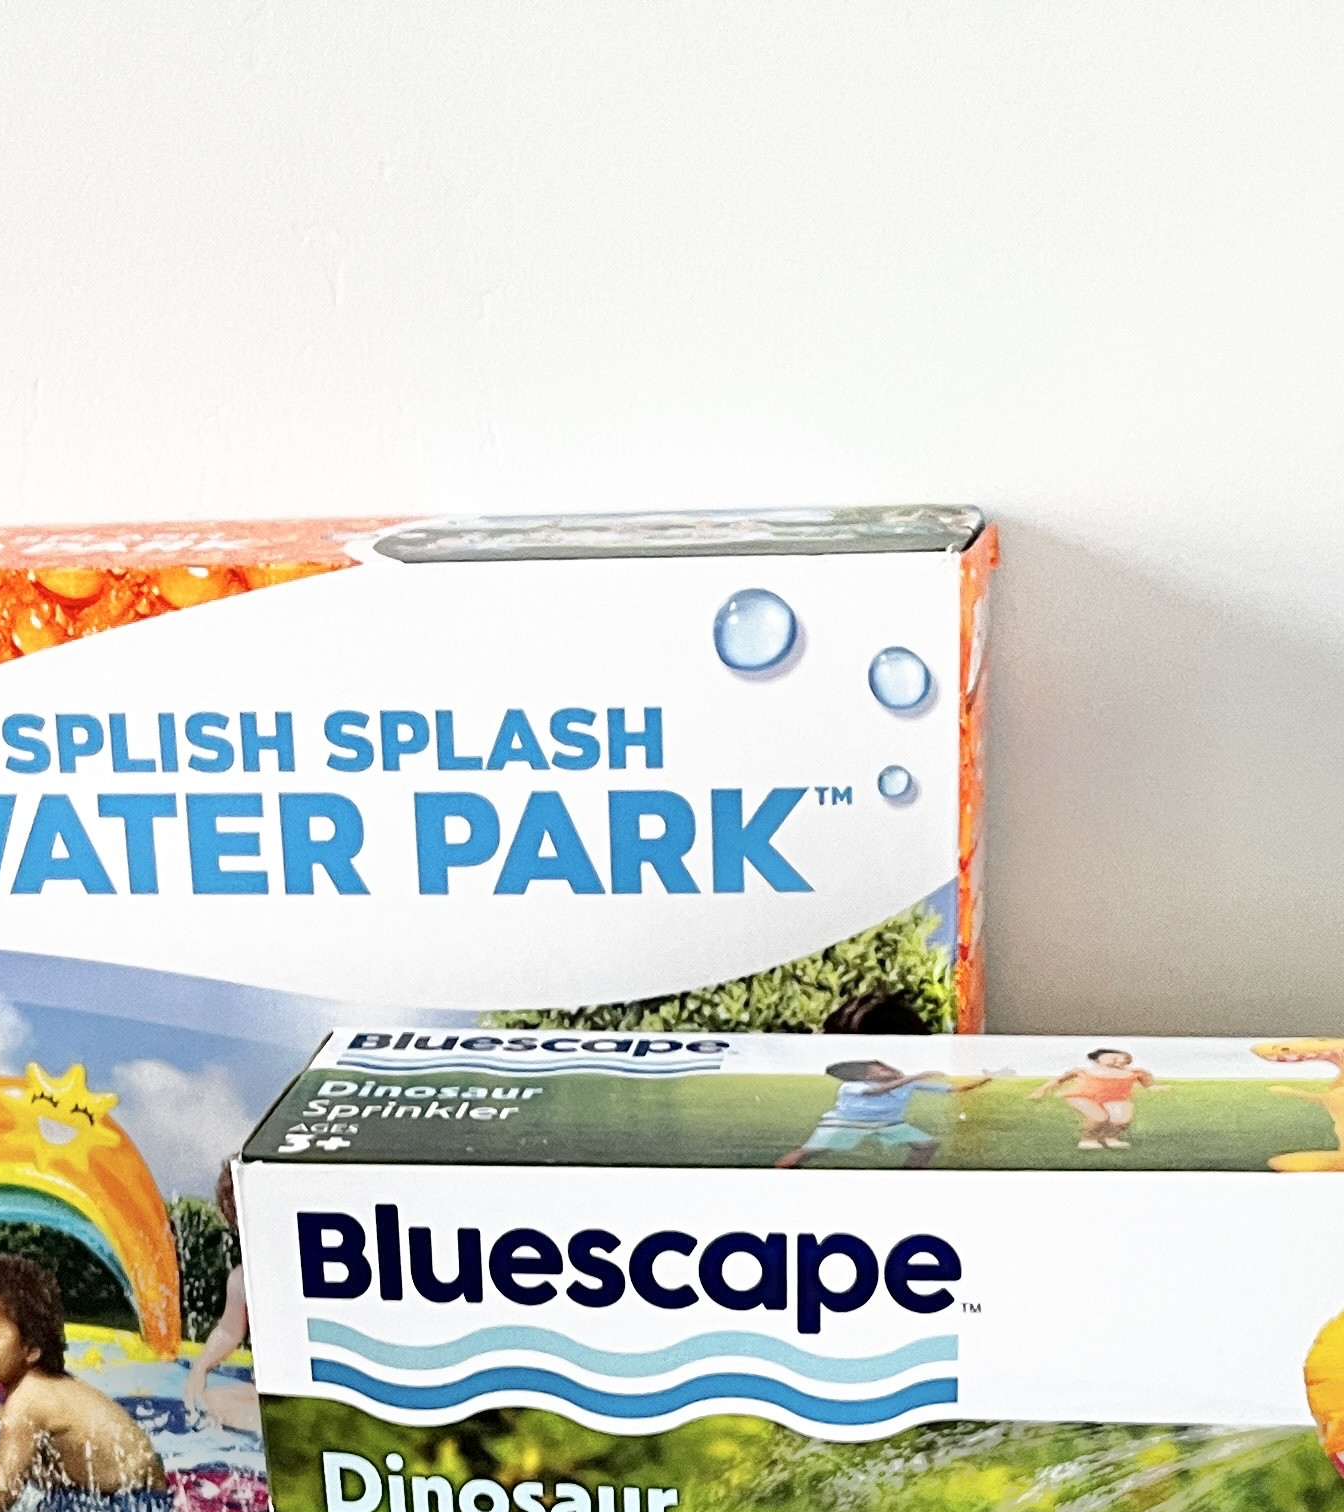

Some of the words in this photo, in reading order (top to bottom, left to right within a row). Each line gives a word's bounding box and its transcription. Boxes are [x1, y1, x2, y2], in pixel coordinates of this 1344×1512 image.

[1, 710, 297, 775] SPLISH
[323, 706, 665, 772] SPLASH
[413, 785, 816, 895] PARK
[346, 1031, 731, 1058] Bluescape
[317, 1079, 544, 1101] Dinosaur
[302, 1099, 519, 1123] Sprinkler
[286, 1122, 359, 1135] AGES
[295, 1203, 963, 1335] Bluescape
